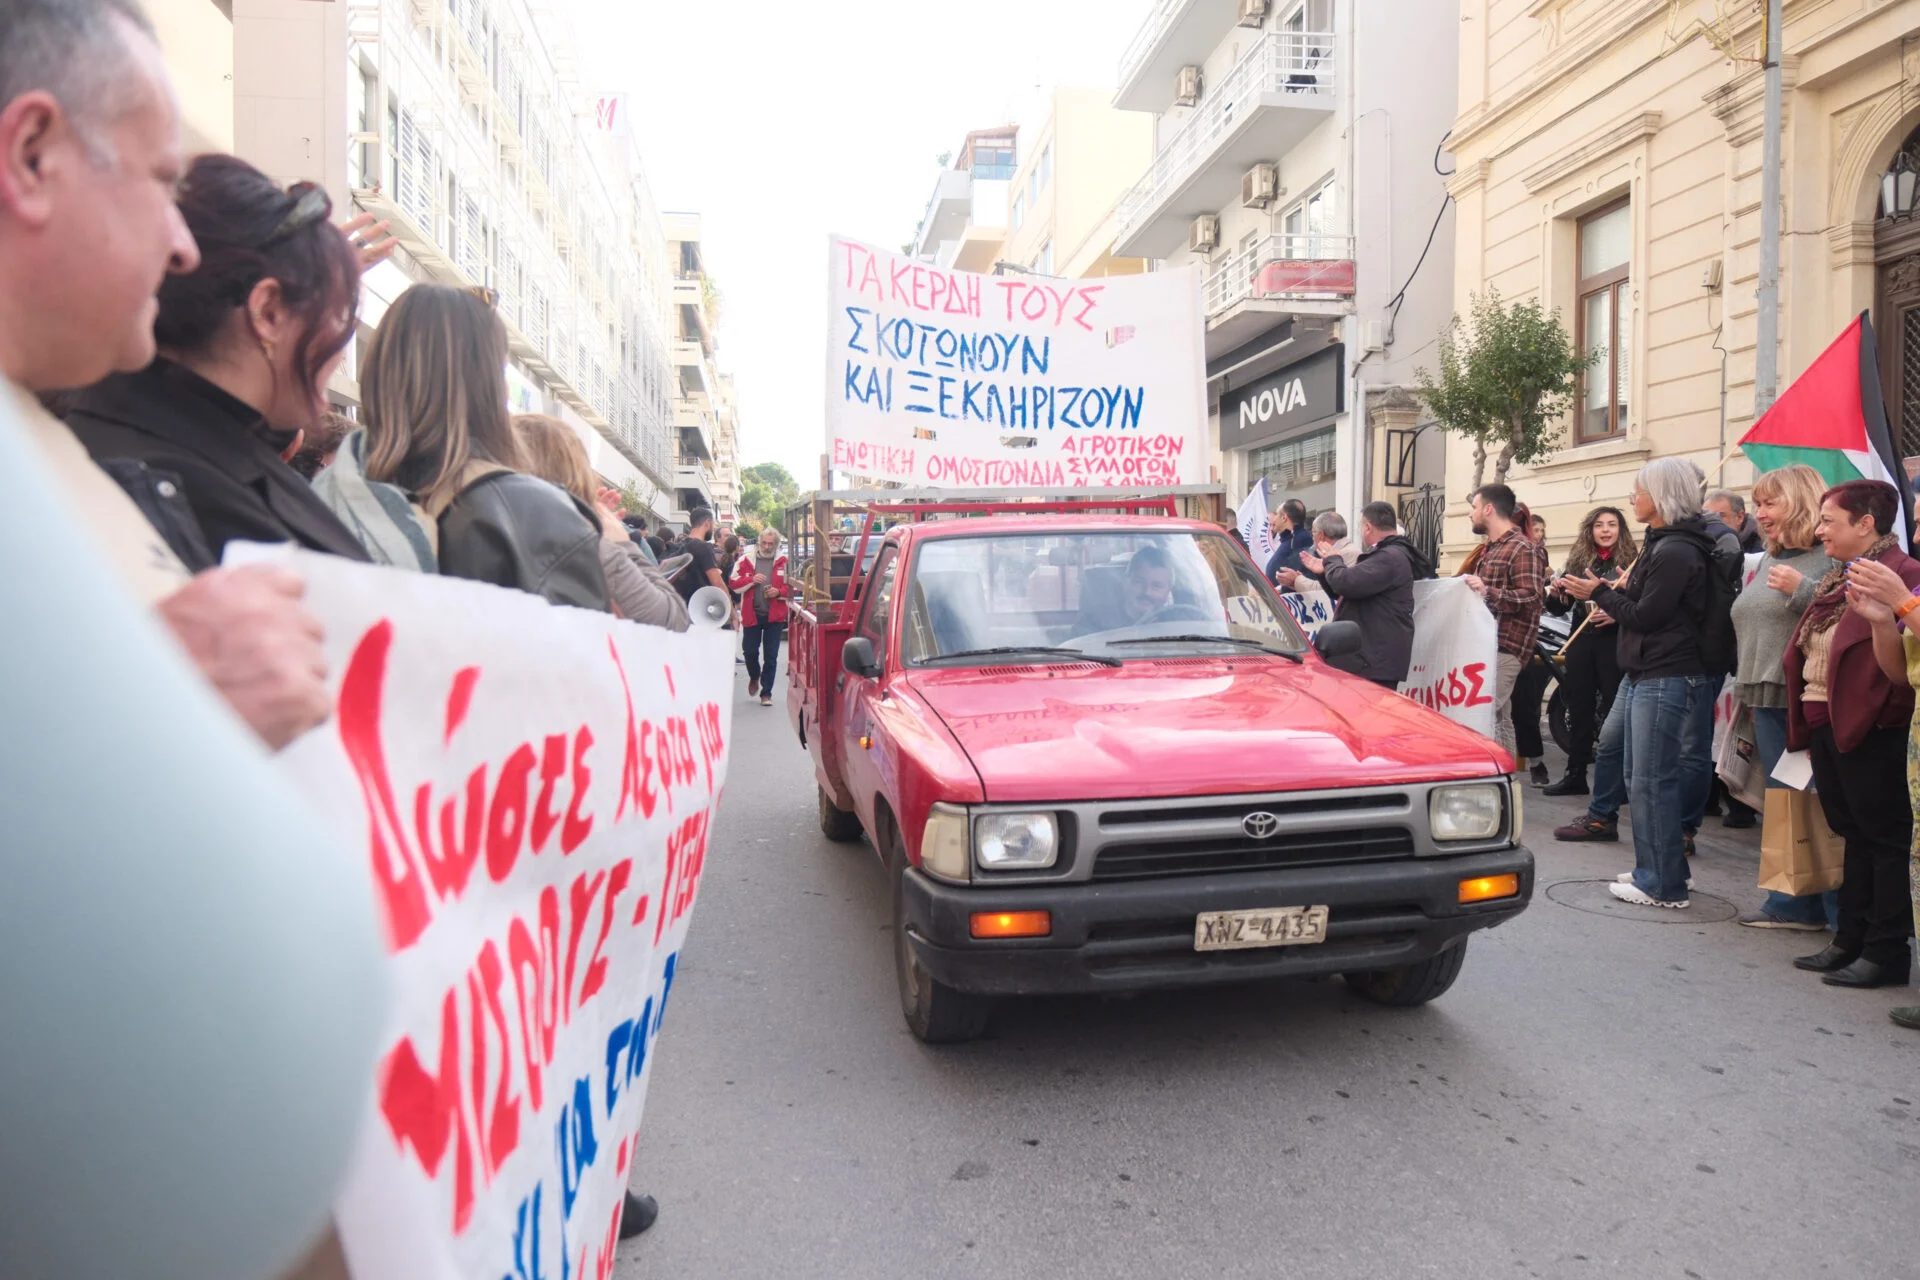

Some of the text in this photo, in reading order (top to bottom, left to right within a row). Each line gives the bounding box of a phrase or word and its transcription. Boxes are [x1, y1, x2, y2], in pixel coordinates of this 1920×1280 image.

[837, 240, 1106, 332] ΤΑ ΚΕΡΔΗ ΤΟΥΣ
[845, 359, 1144, 430] ΚΑΙ ΞΕΚΛΗΡΙΖΟΥΝ
[1240, 378, 1307, 430] NOVA
[926, 454, 1065, 487] ΟΜΟΣΠΟΝΔΙΑ
[1061, 433, 1184, 457] ΑΓΡΟΤΙΚΩΝ
